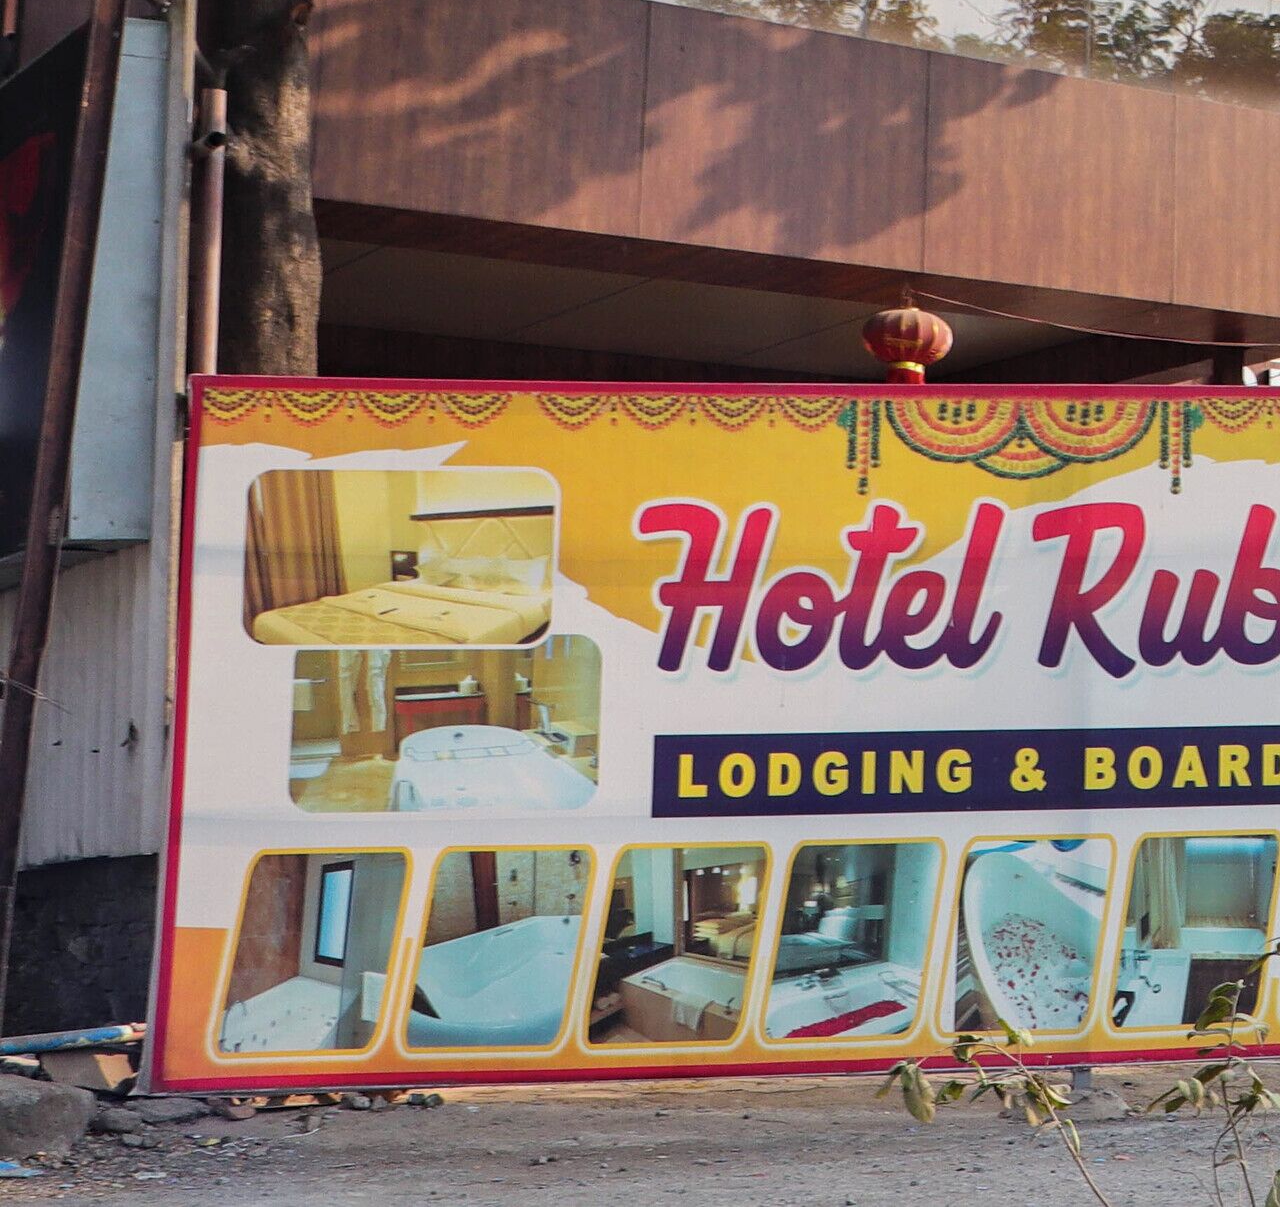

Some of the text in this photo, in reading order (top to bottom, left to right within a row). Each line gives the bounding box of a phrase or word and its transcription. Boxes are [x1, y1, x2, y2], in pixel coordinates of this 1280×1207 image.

[638, 502, 1003, 672] Hotel
[677, 750, 973, 799] LODGING
[1009, 748, 1047, 791] &
